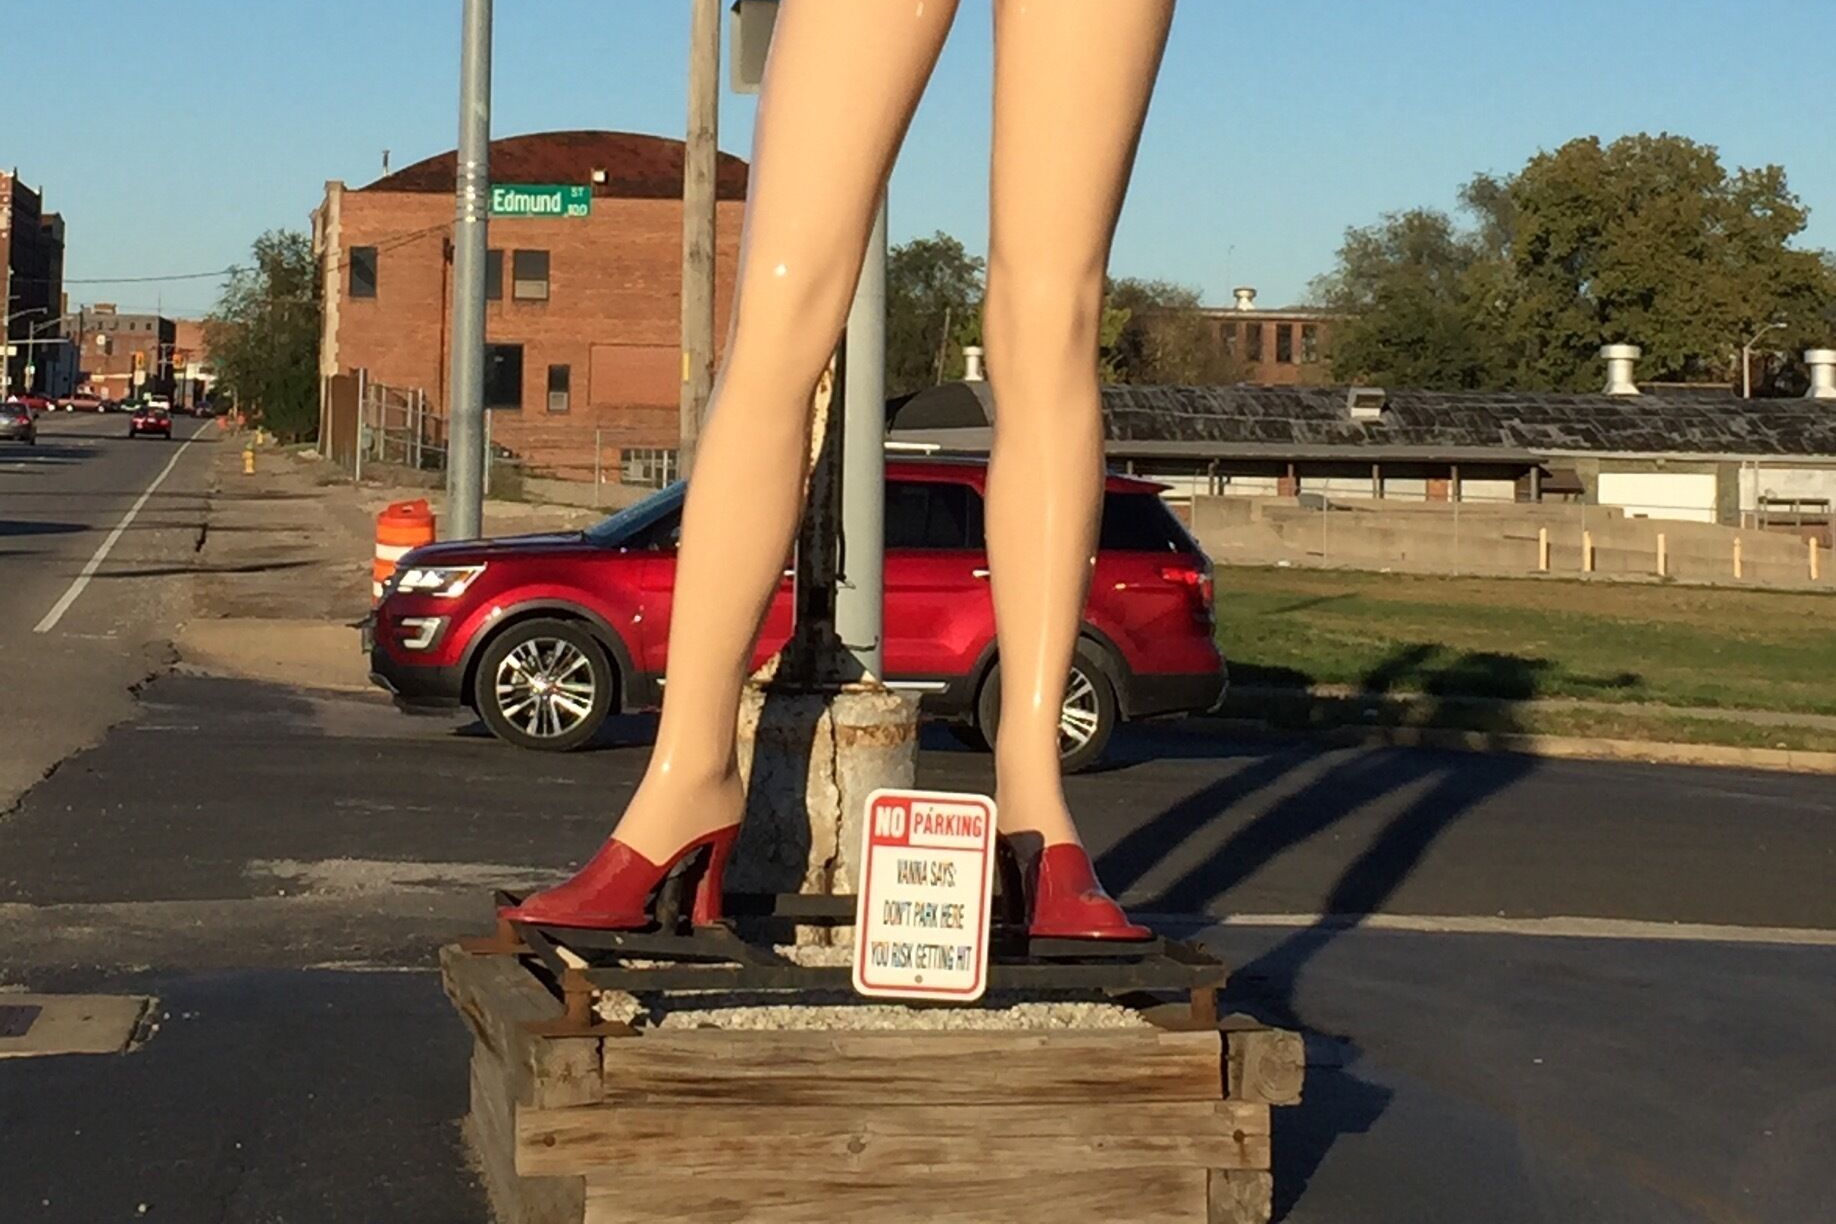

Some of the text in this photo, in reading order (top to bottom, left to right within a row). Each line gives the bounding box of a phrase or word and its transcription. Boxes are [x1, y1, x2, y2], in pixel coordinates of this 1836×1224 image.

[493, 188, 562, 213] Edmund
[570, 186, 584, 197] ST
[874, 805, 983, 839] NO PARKING
[897, 859, 928, 885] VANNA
[883, 899, 965, 930] DON'T PARK HERE
[871, 941, 973, 971] YOU RISK GETTING HIT
